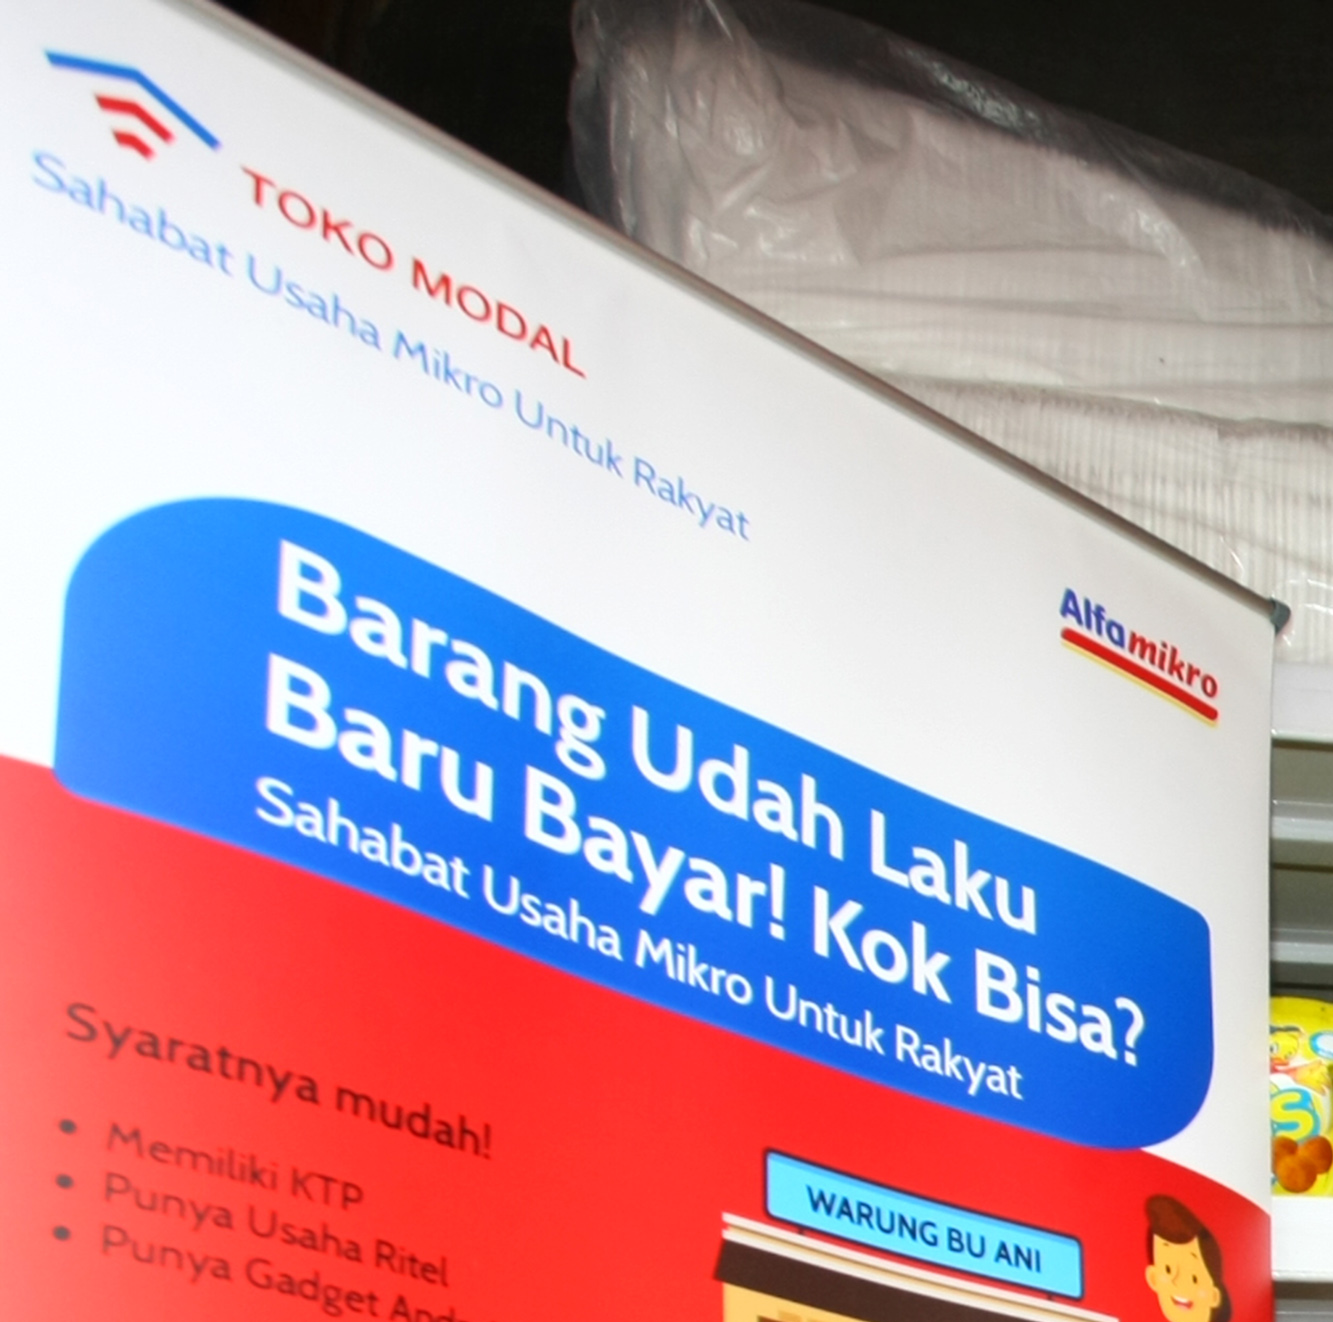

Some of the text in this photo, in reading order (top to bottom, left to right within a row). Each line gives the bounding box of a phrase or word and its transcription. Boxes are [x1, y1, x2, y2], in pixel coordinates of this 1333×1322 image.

[31, 150, 750, 542] Sahabat Usaha Mikro Untuk Rakyat
[241, 165, 587, 379] TOKO MODAL
[1059, 587, 1218, 699] Alfamikro
[277, 538, 1037, 935] Barang Udah Laku
[255, 775, 1024, 1101] Sahabat Usaha Mikro Untuk Rakyat
[265, 652, 1146, 1067] Baru Bayar! Kok Bisa?
[66, 1002, 493, 1160] Syaratnya mudah!
[104, 1172, 450, 1288] Punya Usaha Ritel
[107, 1122, 365, 1211] Memiliki KTP
[806, 1183, 1042, 1275] WARUNG BU ANI
[102, 1224, 233, 1285] Punya
[246, 1257, 379, 1318] Gadget
